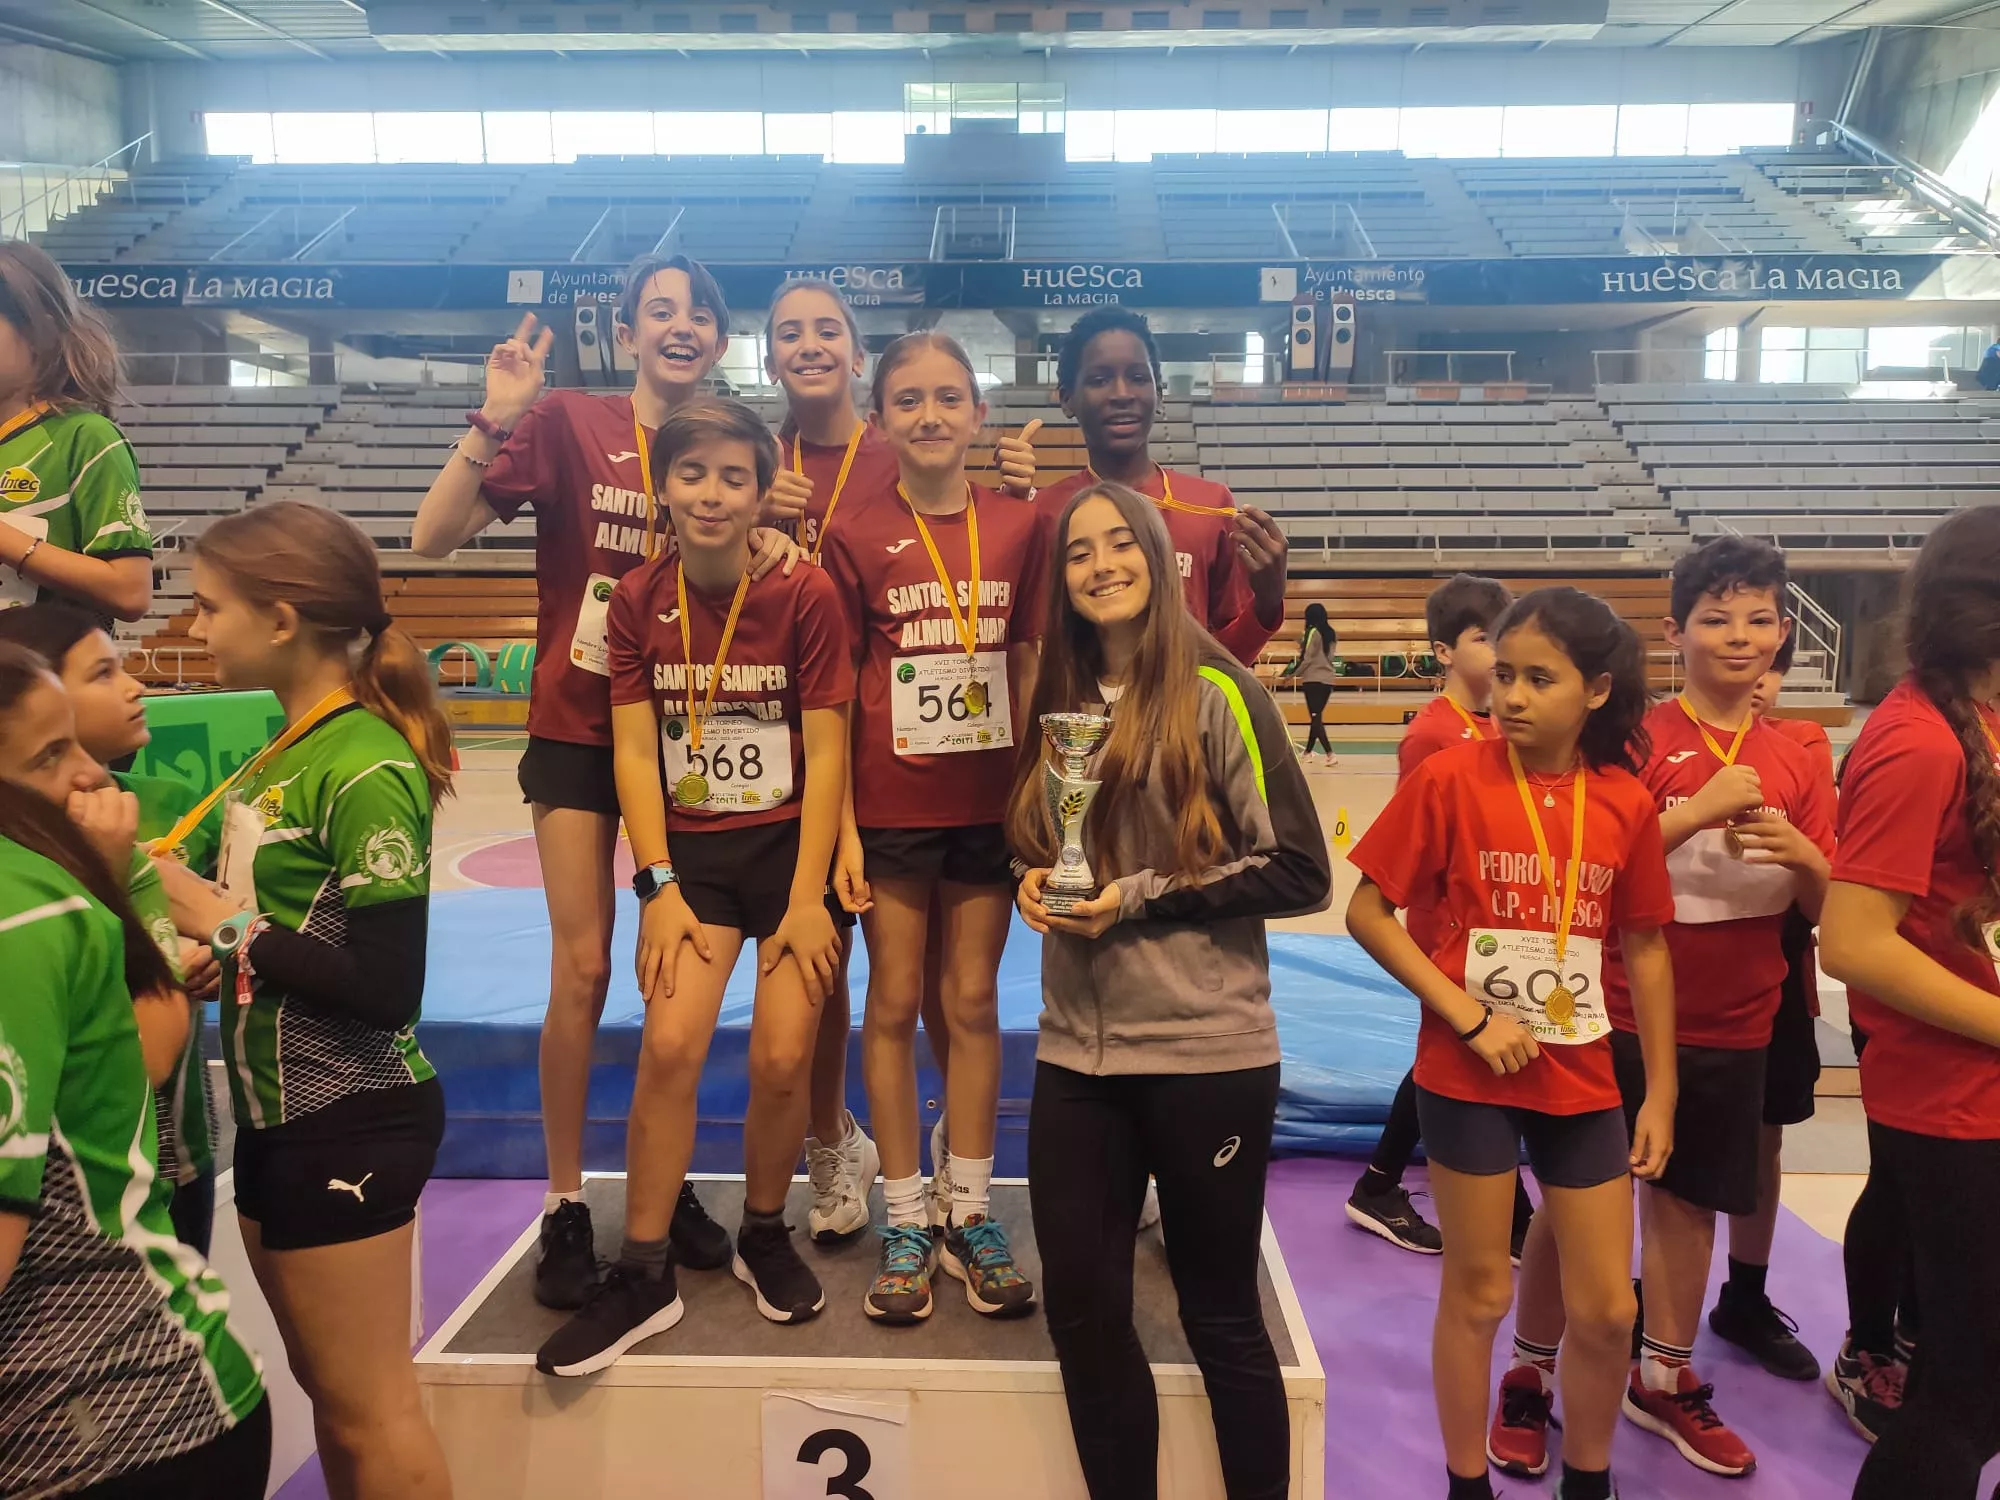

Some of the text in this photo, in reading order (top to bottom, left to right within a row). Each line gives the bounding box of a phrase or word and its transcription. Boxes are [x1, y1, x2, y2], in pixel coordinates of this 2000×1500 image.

[549, 270, 626, 289] Ayuntam
[1304, 267, 1425, 286] Ayuntamiento
[548, 290, 568, 304] de
[956, 580, 1010, 608] SMPER
[722, 664, 788, 692] SAMPER
[685, 743, 763, 781] 568
[1336, 821, 1345, 836] 0
[1479, 850, 1542, 886] PEDRO
[1492, 889, 1526, 920] C.P.
[1484, 965, 1592, 1010] 602
[796, 1428, 876, 1500] 3
